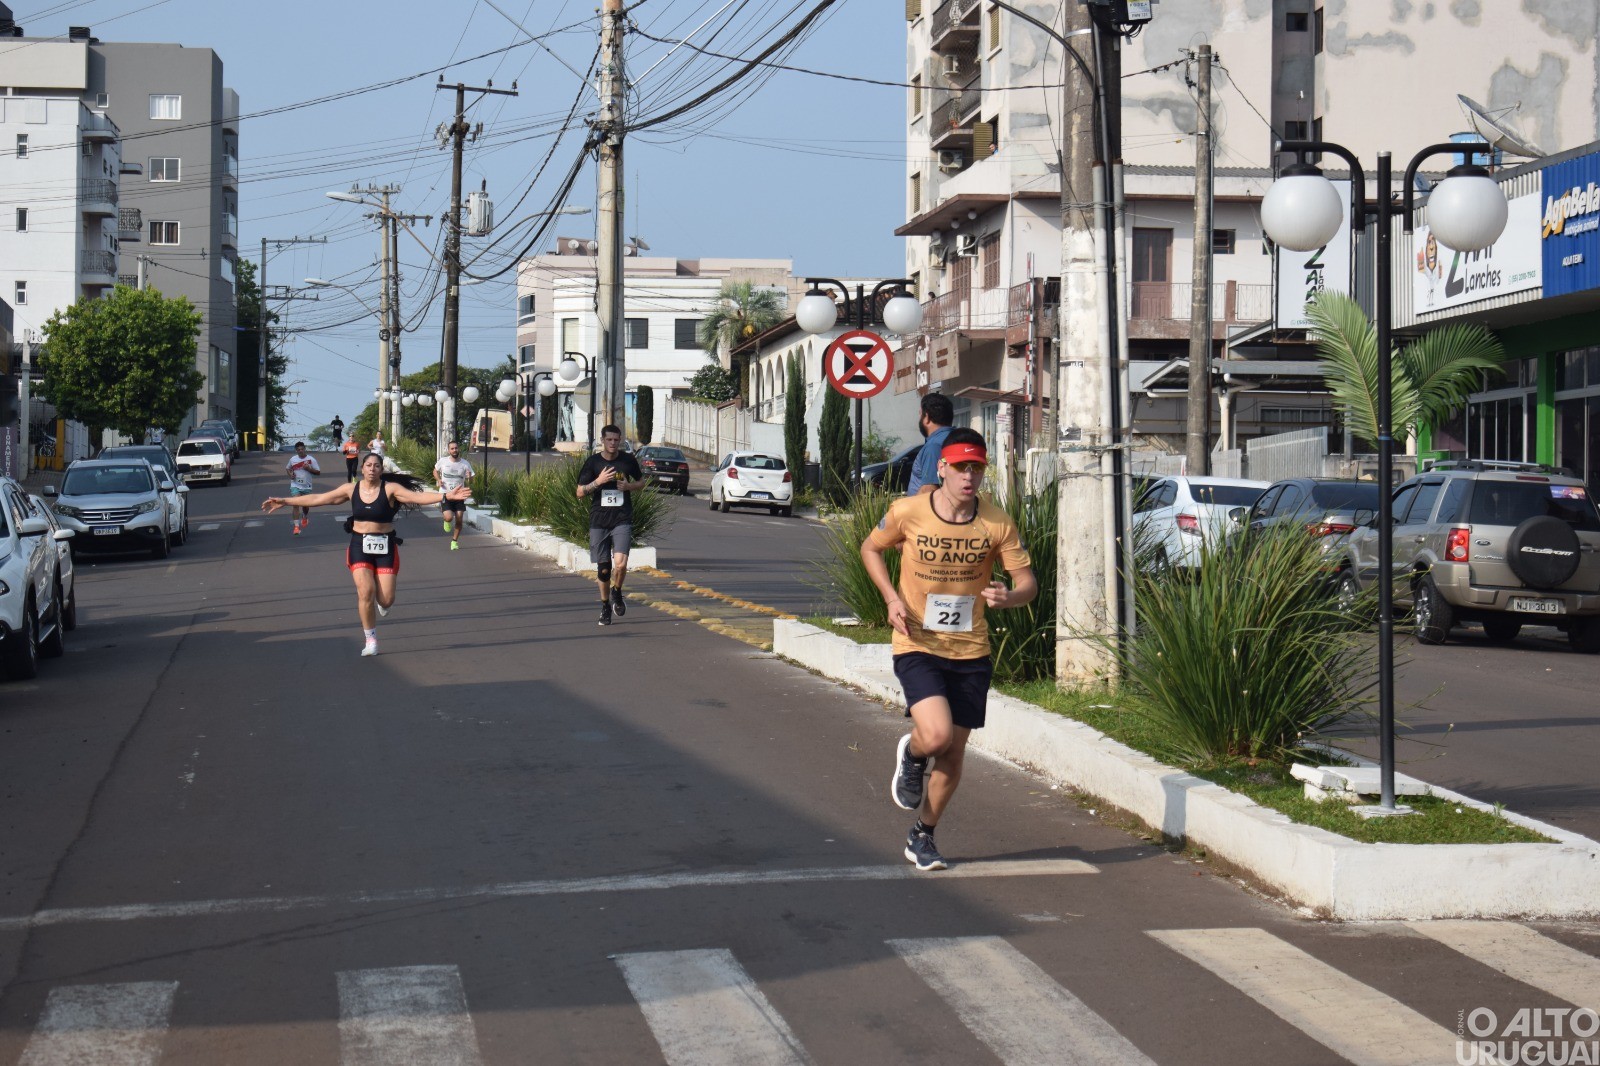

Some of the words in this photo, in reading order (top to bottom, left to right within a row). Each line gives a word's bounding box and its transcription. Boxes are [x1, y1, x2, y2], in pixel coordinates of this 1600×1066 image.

[1542, 182, 1600, 232] AgroBella
[1465, 264, 1501, 294] Lanches
[917, 535, 991, 550] RÚSTICA
[920, 550, 936, 561] 10
[940, 552, 987, 563] ANOS
[914, 572, 948, 583] FREDERICO
[937, 611, 961, 626] 22
